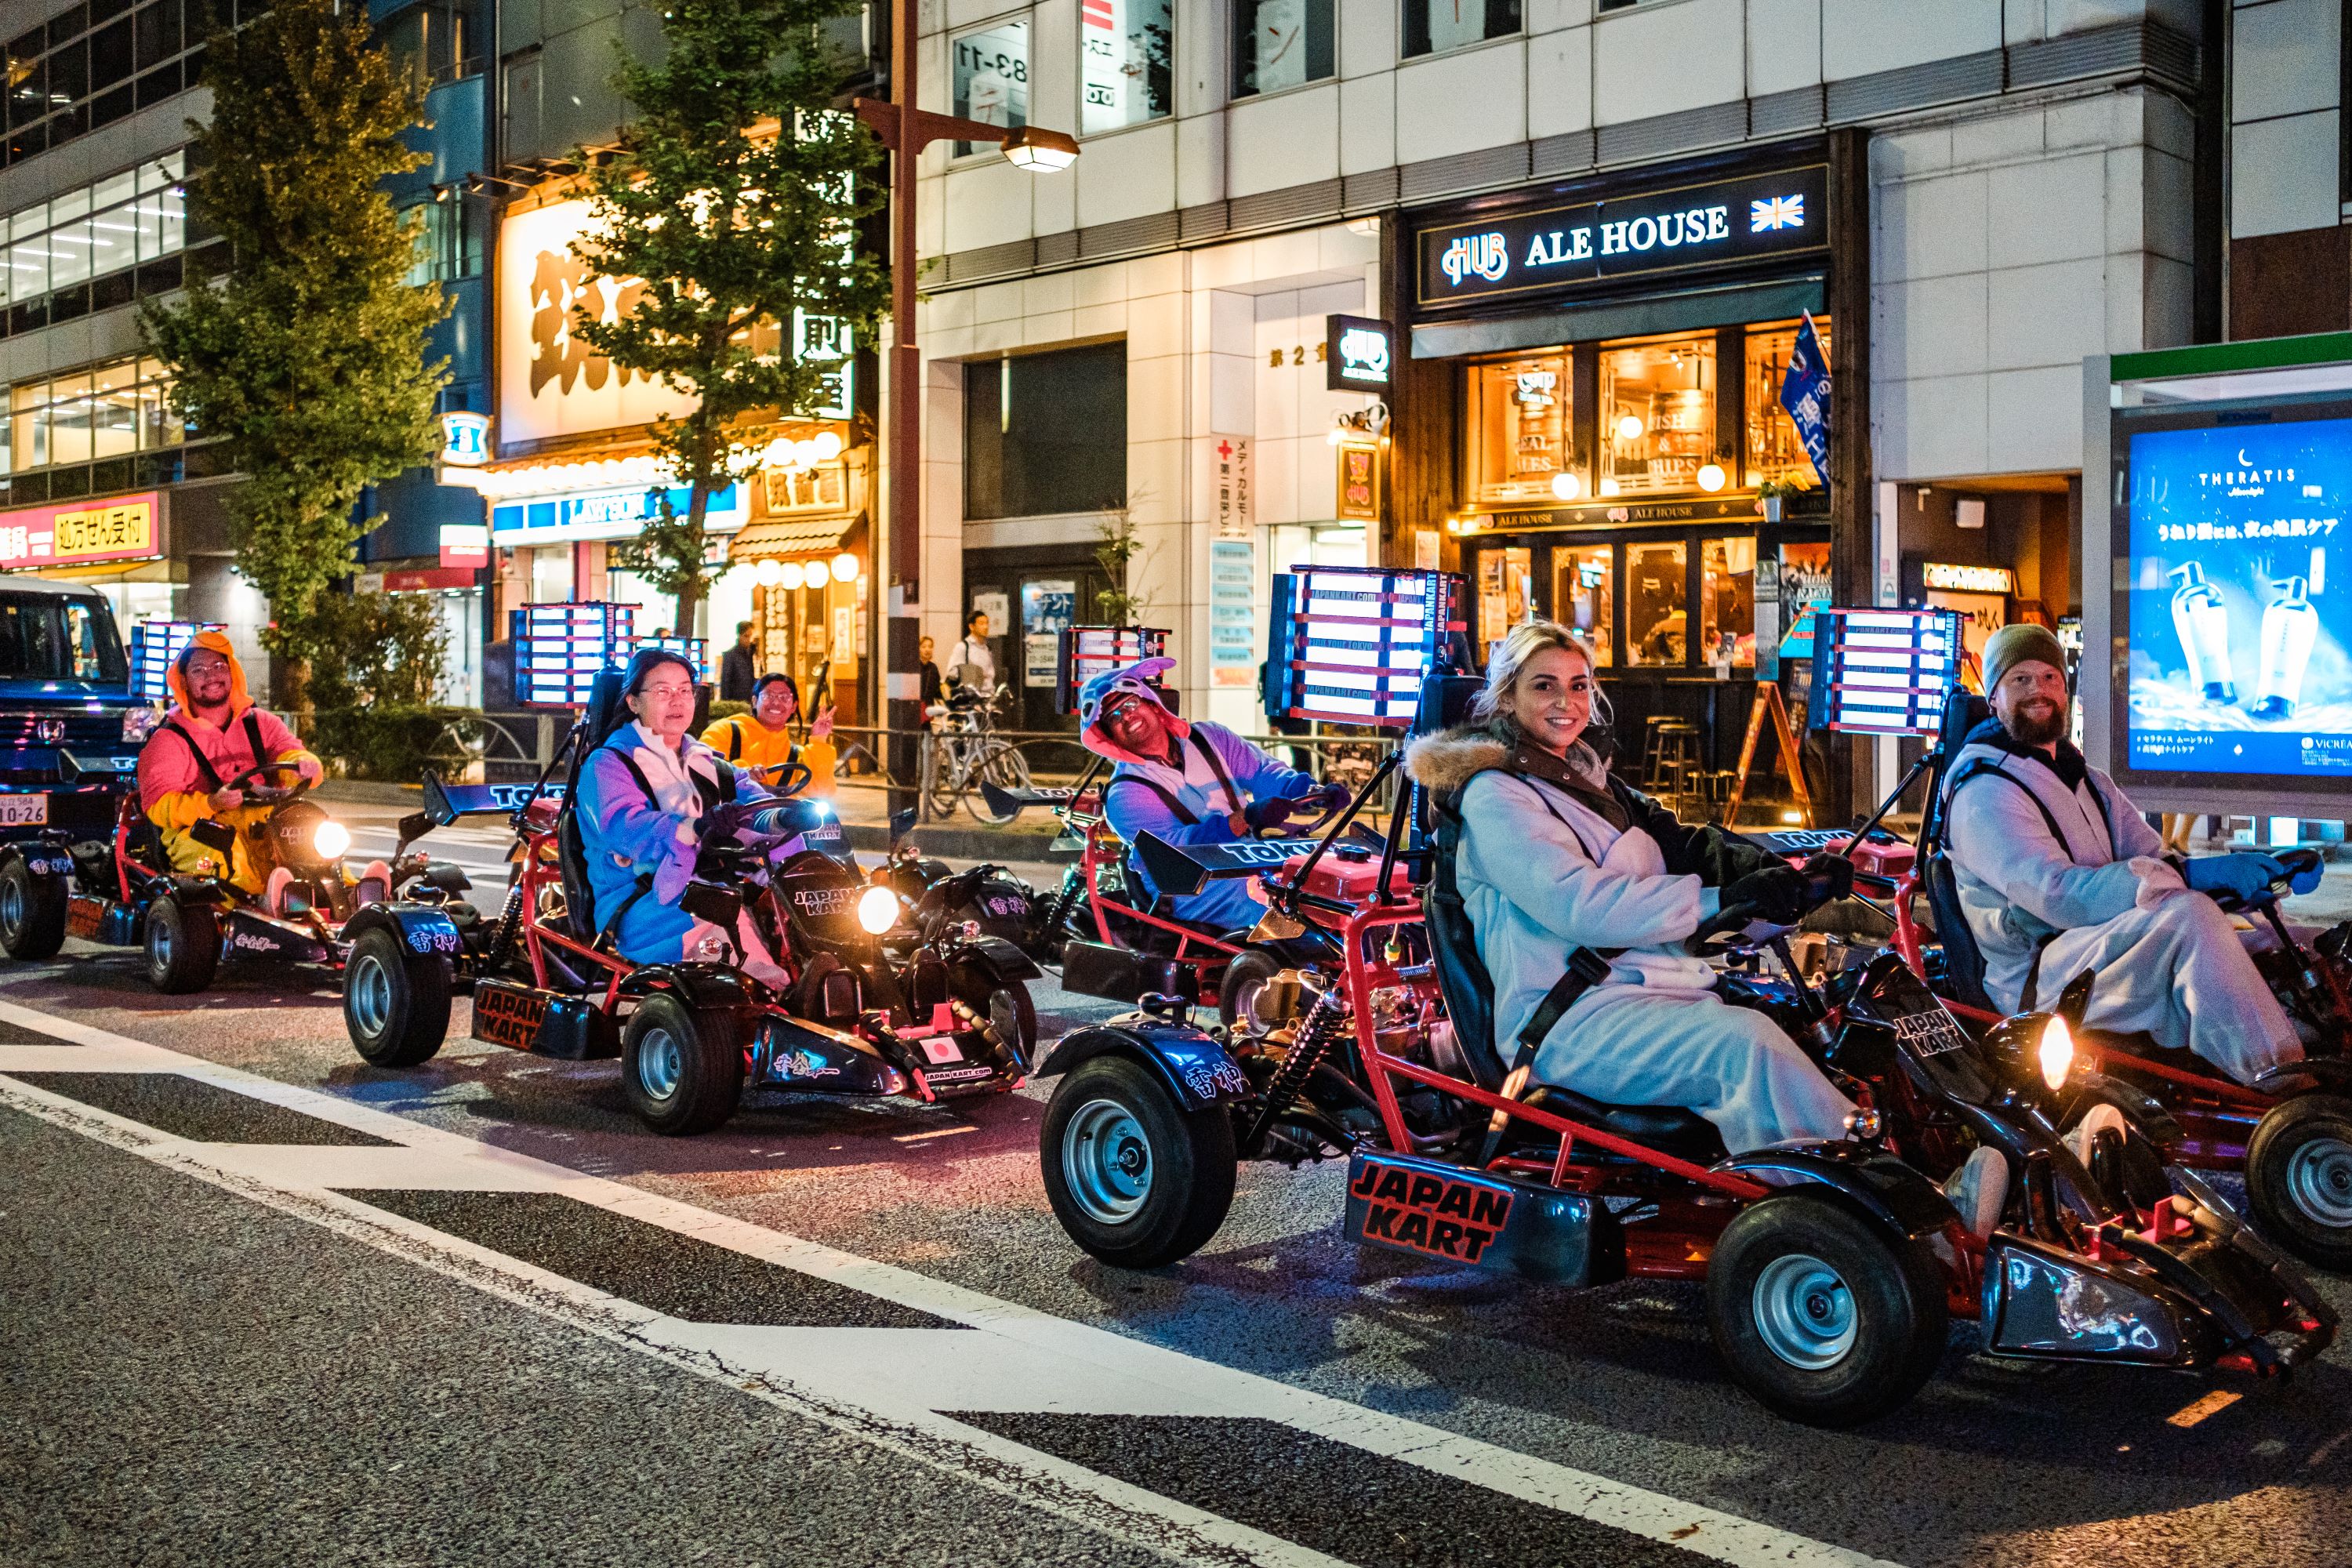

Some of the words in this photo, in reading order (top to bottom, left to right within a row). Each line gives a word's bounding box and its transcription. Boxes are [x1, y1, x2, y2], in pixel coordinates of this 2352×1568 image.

[1441, 232, 1509, 287] HUB
[1525, 227, 1593, 267] ALE
[1600, 205, 1729, 255] HOUSE
[1340, 328, 1390, 372] HUB
[2198, 468, 2296, 486] THERATIS
[59, 511, 142, 550] 処方せん受付
[1424, 572, 1437, 633] JAPANKART
[1436, 573, 1447, 633] JAPANKART
[408, 930, 457, 953] 雷神
[477, 987, 547, 1027] JAPAN
[1893, 1008, 1955, 1040] JAPAN
[480, 1012, 541, 1051] KART
[1911, 1027, 1963, 1058] KART
[1185, 1060, 1244, 1099] 雷神
[1351, 1160, 1514, 1232] JAPAN
[1362, 1200, 1497, 1265] KART
